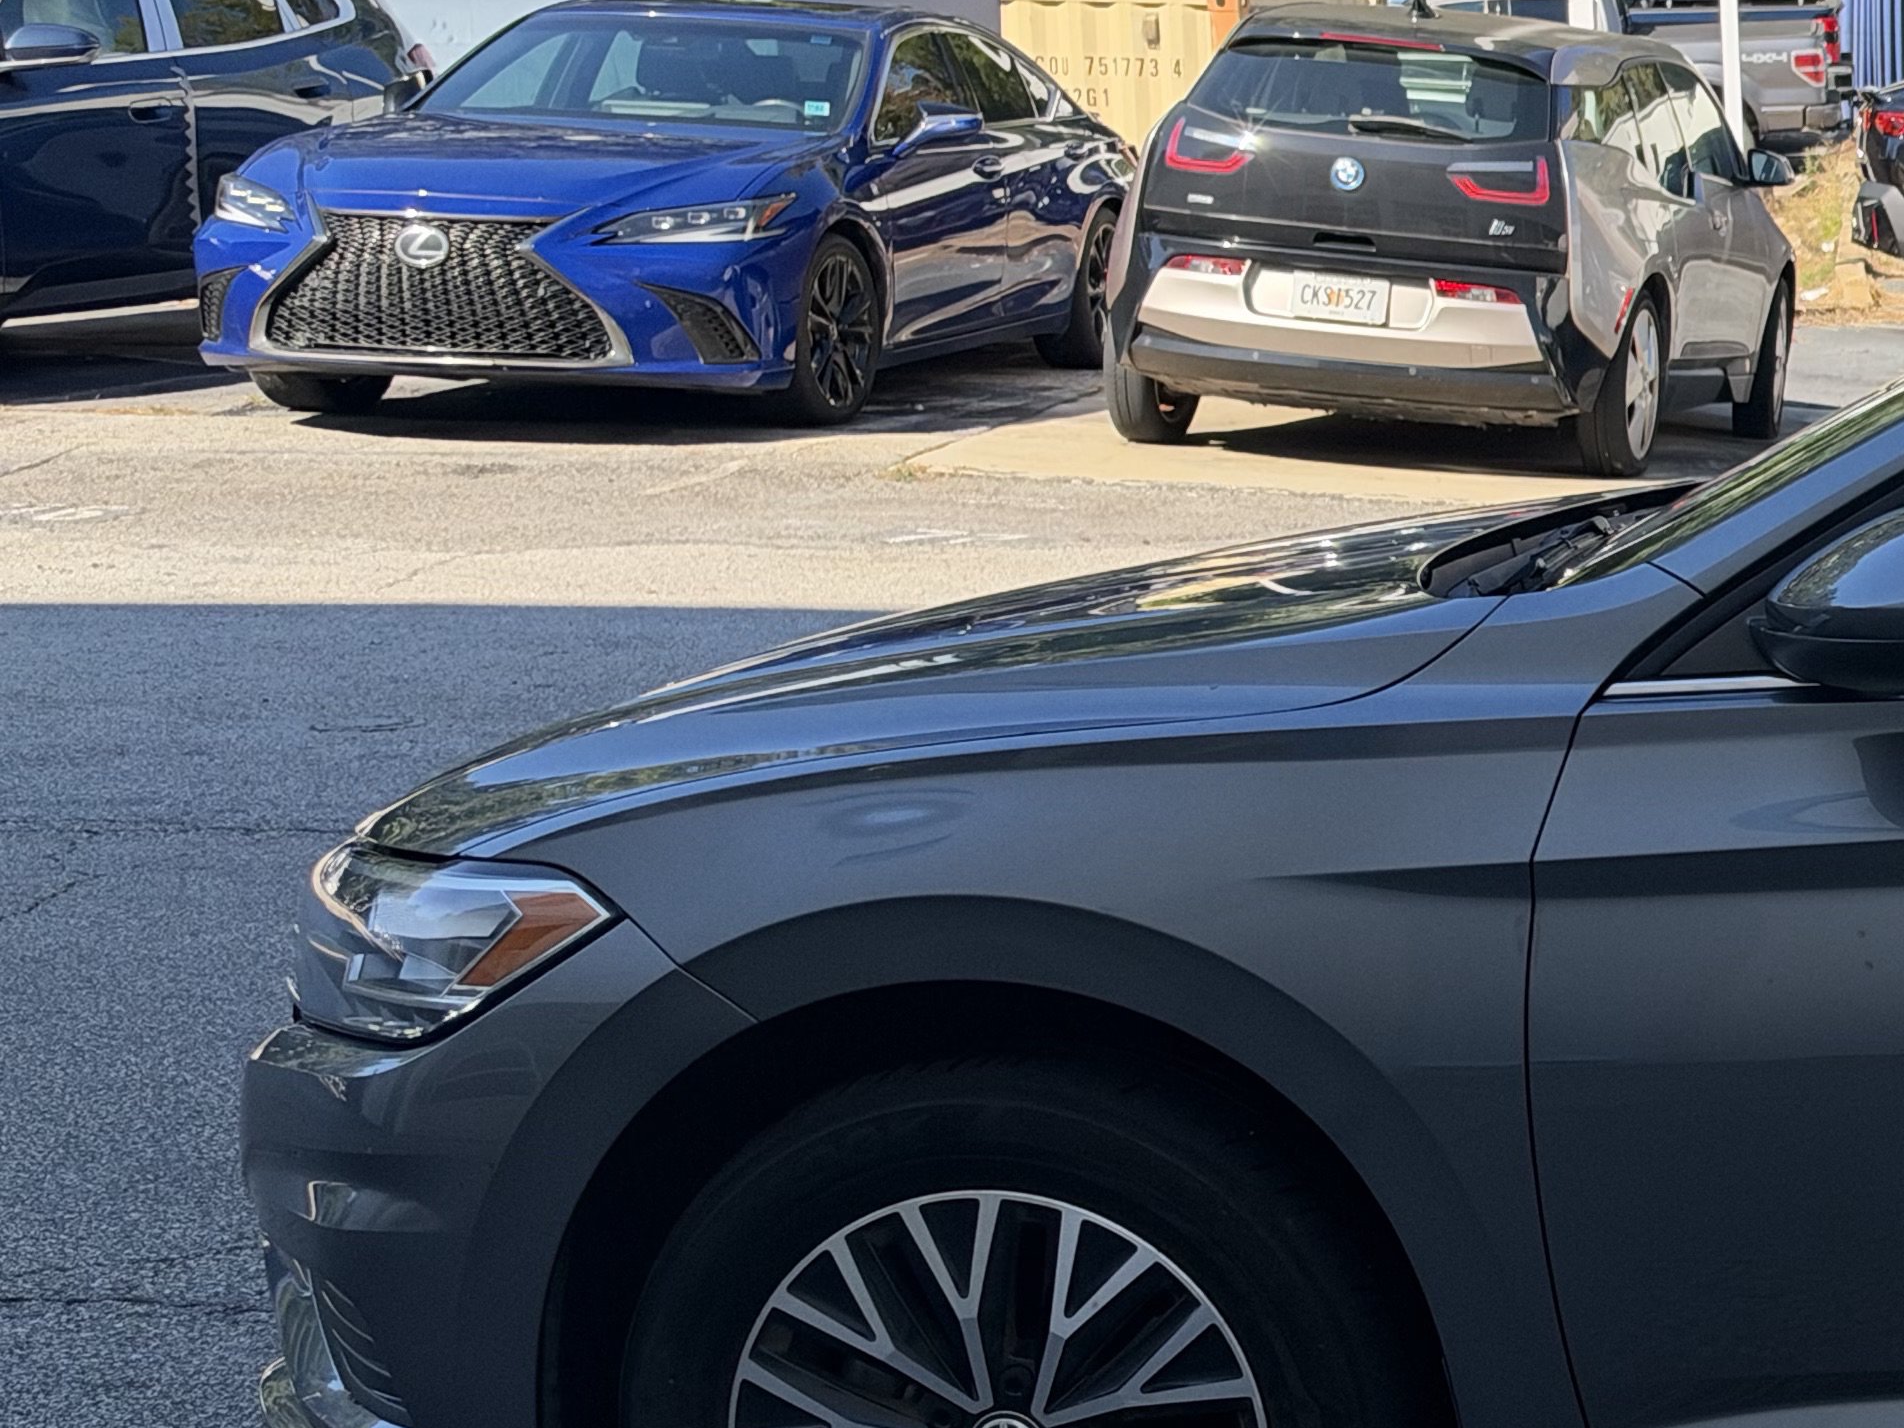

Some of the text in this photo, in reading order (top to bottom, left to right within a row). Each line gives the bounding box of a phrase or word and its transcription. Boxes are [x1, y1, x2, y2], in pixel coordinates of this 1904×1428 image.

[1084, 56, 1159, 78] 751773
[1173, 58, 1183, 78] 4
[1300, 283, 1377, 311] CKS1527
